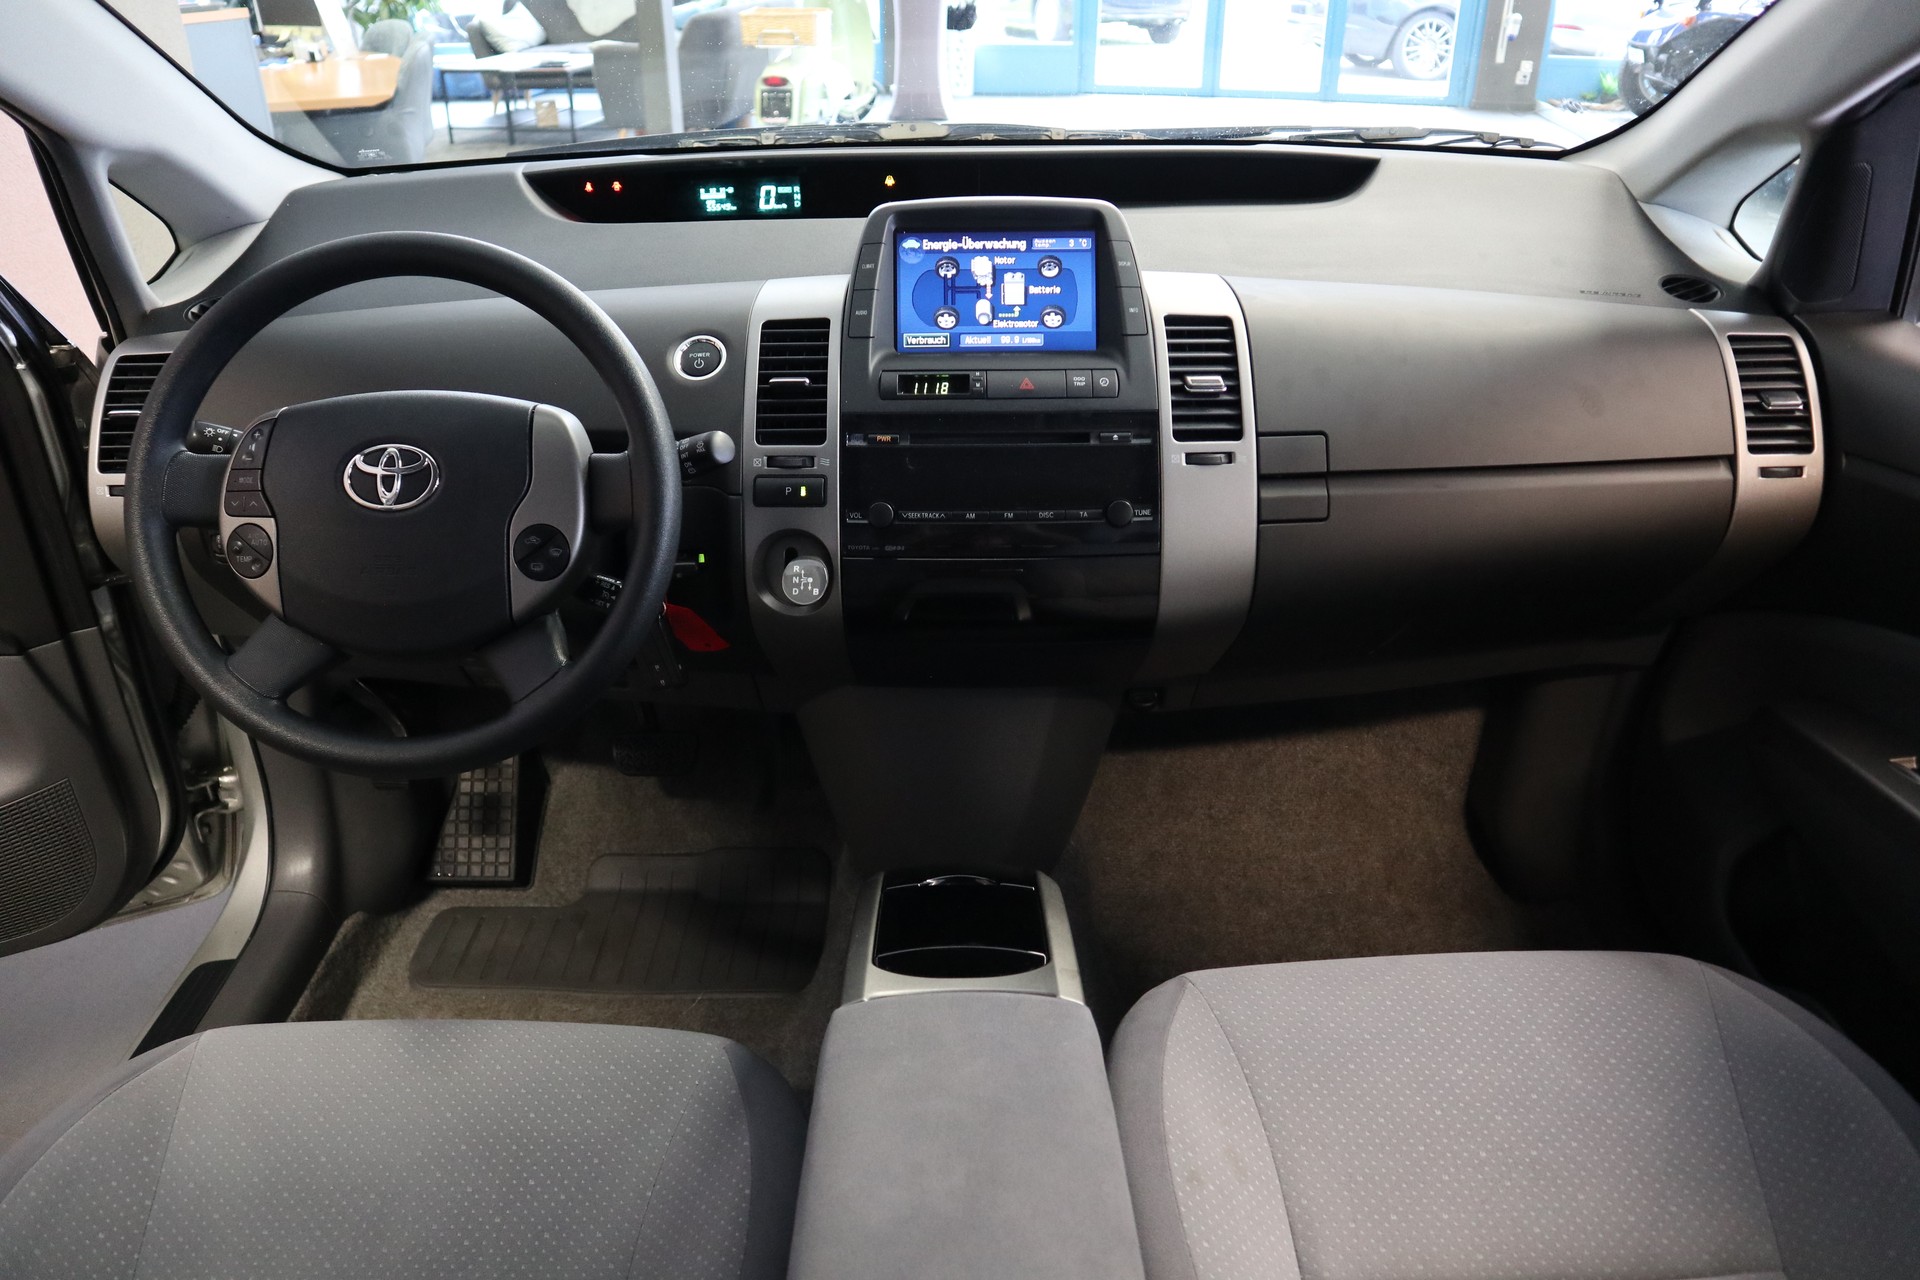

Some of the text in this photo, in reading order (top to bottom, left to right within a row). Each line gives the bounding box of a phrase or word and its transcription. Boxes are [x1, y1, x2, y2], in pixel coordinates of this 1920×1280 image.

[922, 236, 1027, 252] Energie-Überwachung
[1068, 239, 1075, 248] 3
[994, 256, 1016, 265] Motor
[1028, 285, 1061, 295] Batterie
[992, 320, 1039, 329] Elektromotor
[906, 336, 947, 345] Verbrauch
[964, 336, 992, 345] Aktuell
[217, 427, 230, 435] OFF
[785, 487, 792, 496] P
[1038, 511, 1054, 519] DISC
[1134, 508, 1152, 516] TUNE
[251, 538, 268, 546] AUTO
[235, 554, 253, 563] TEMP
[793, 565, 800, 573] R
[792, 576, 799, 584] N
[792, 588, 799, 596] D
[812, 588, 819, 596] B
